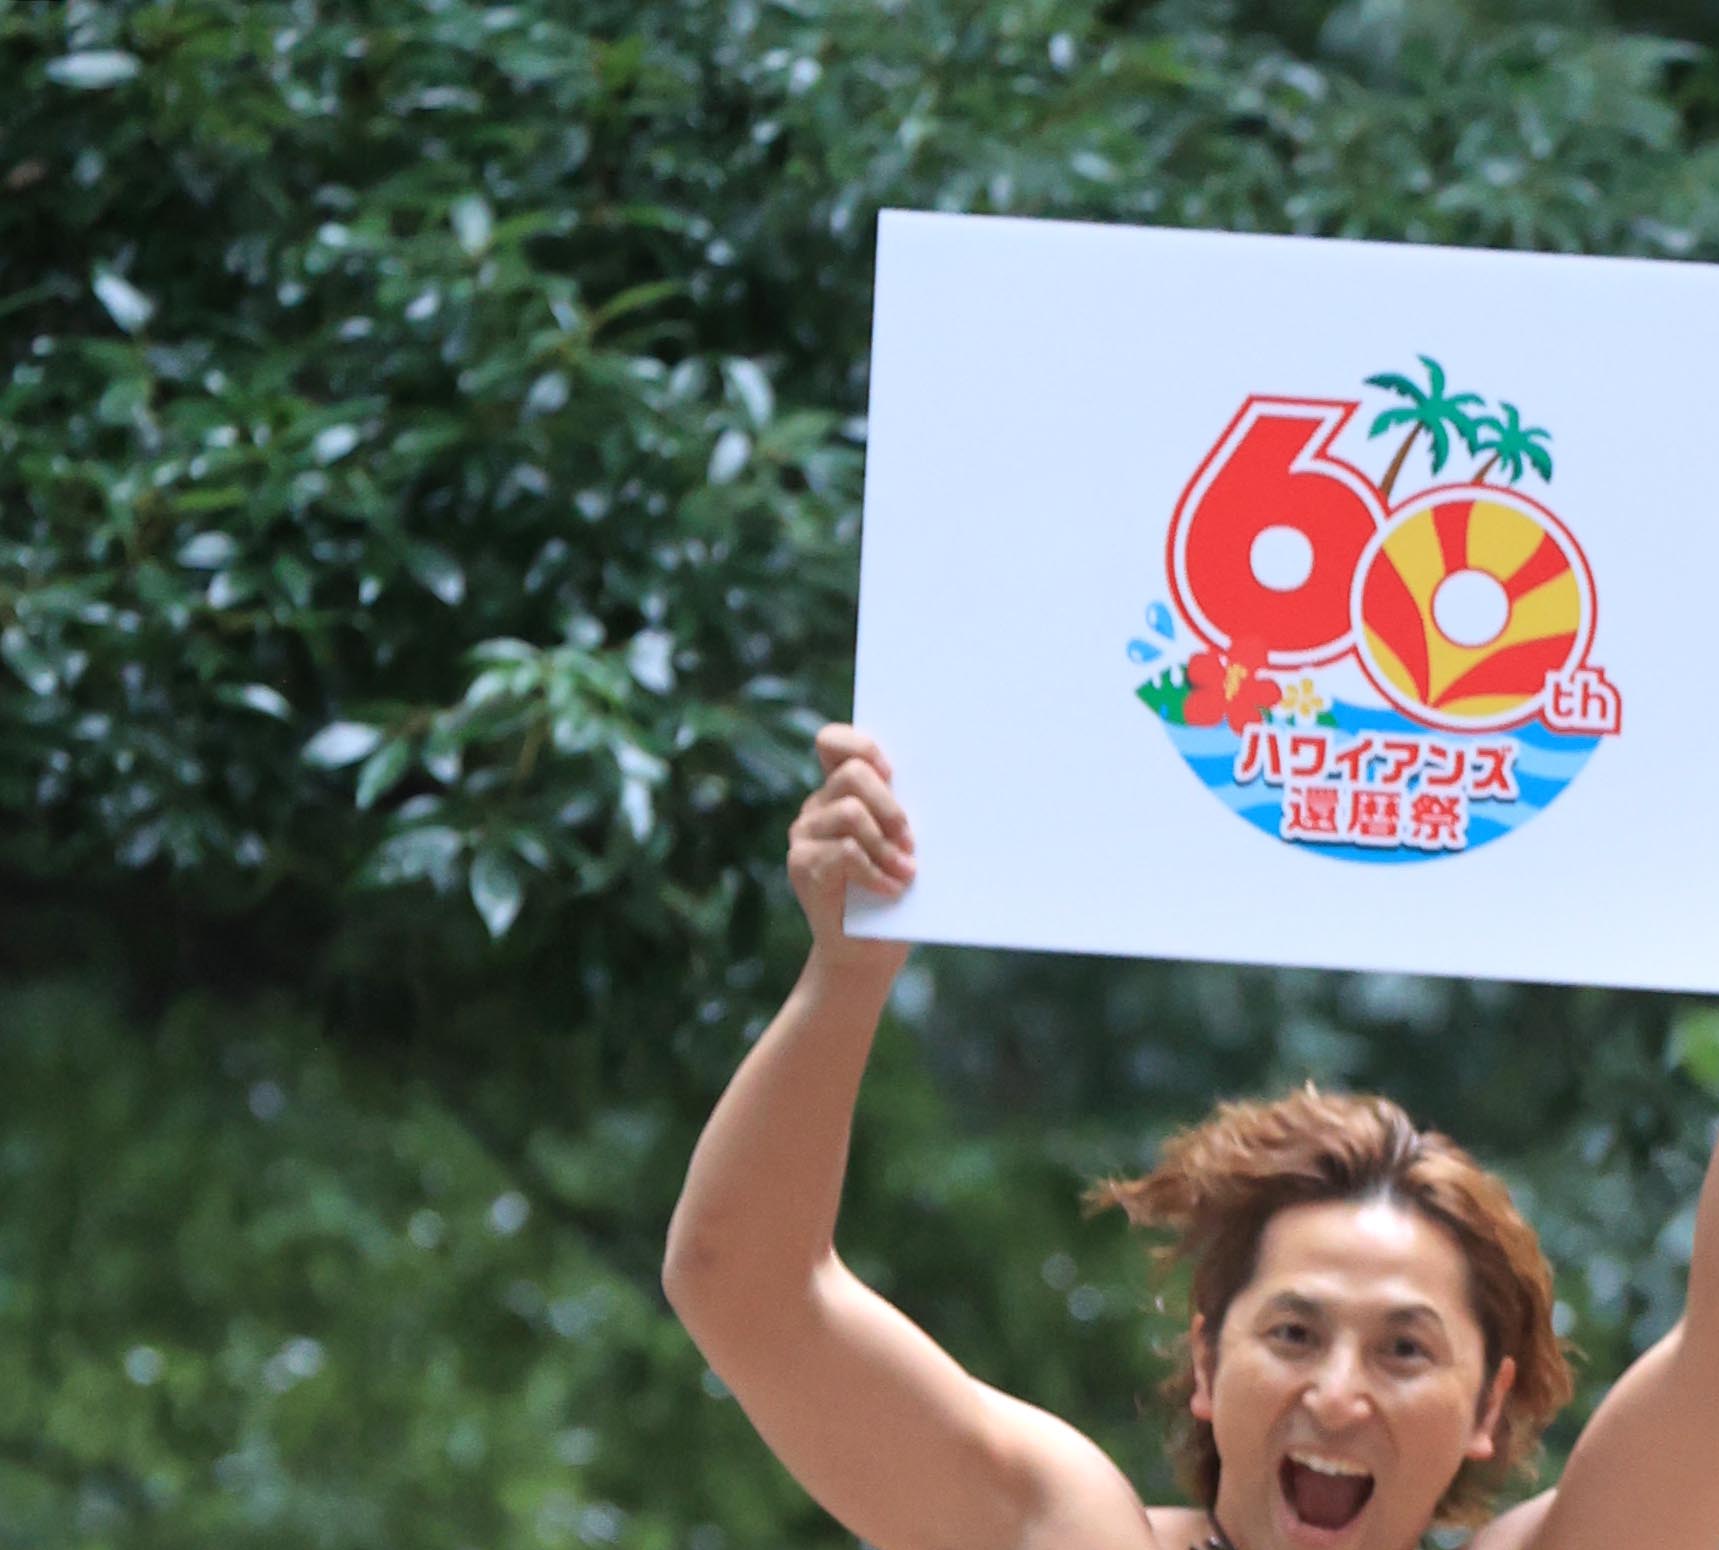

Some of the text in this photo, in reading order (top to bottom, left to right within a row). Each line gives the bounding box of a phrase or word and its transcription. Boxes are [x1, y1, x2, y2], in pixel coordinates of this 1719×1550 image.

[1241, 733, 1512, 792] ハワイアンズ
[1288, 787, 1462, 842] 還暦祭
